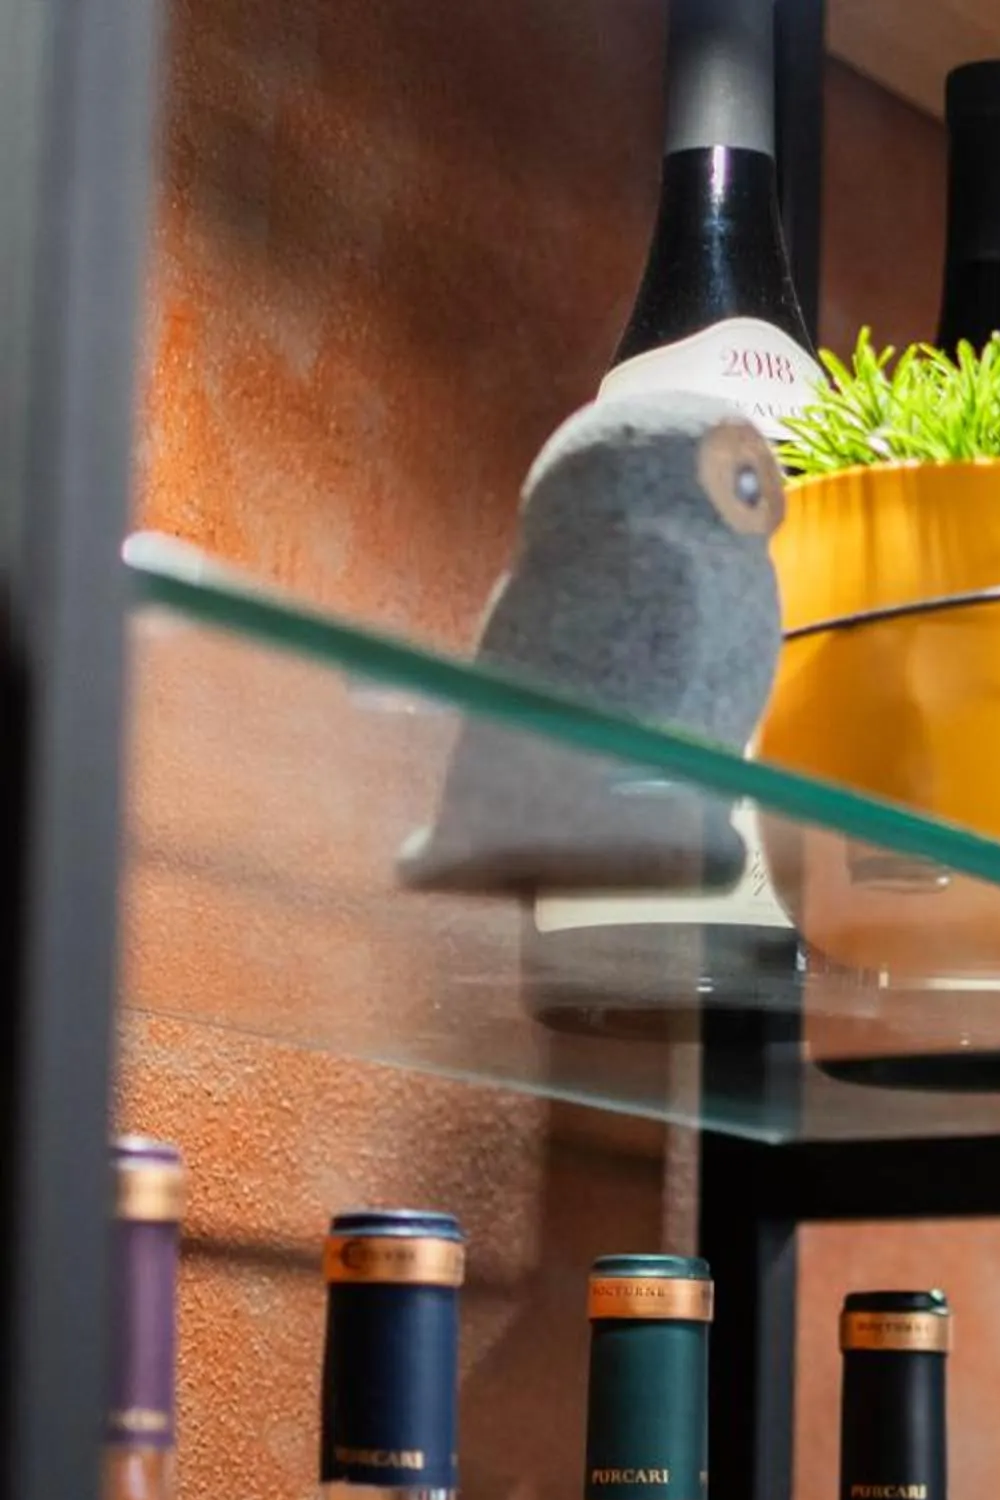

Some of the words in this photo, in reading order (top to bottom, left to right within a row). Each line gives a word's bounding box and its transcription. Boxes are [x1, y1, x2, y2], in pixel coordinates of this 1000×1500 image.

[721, 350, 795, 384] 2018
[592, 1468, 669, 1484] PURCARI
[851, 1484, 927, 1500] PURCARI
